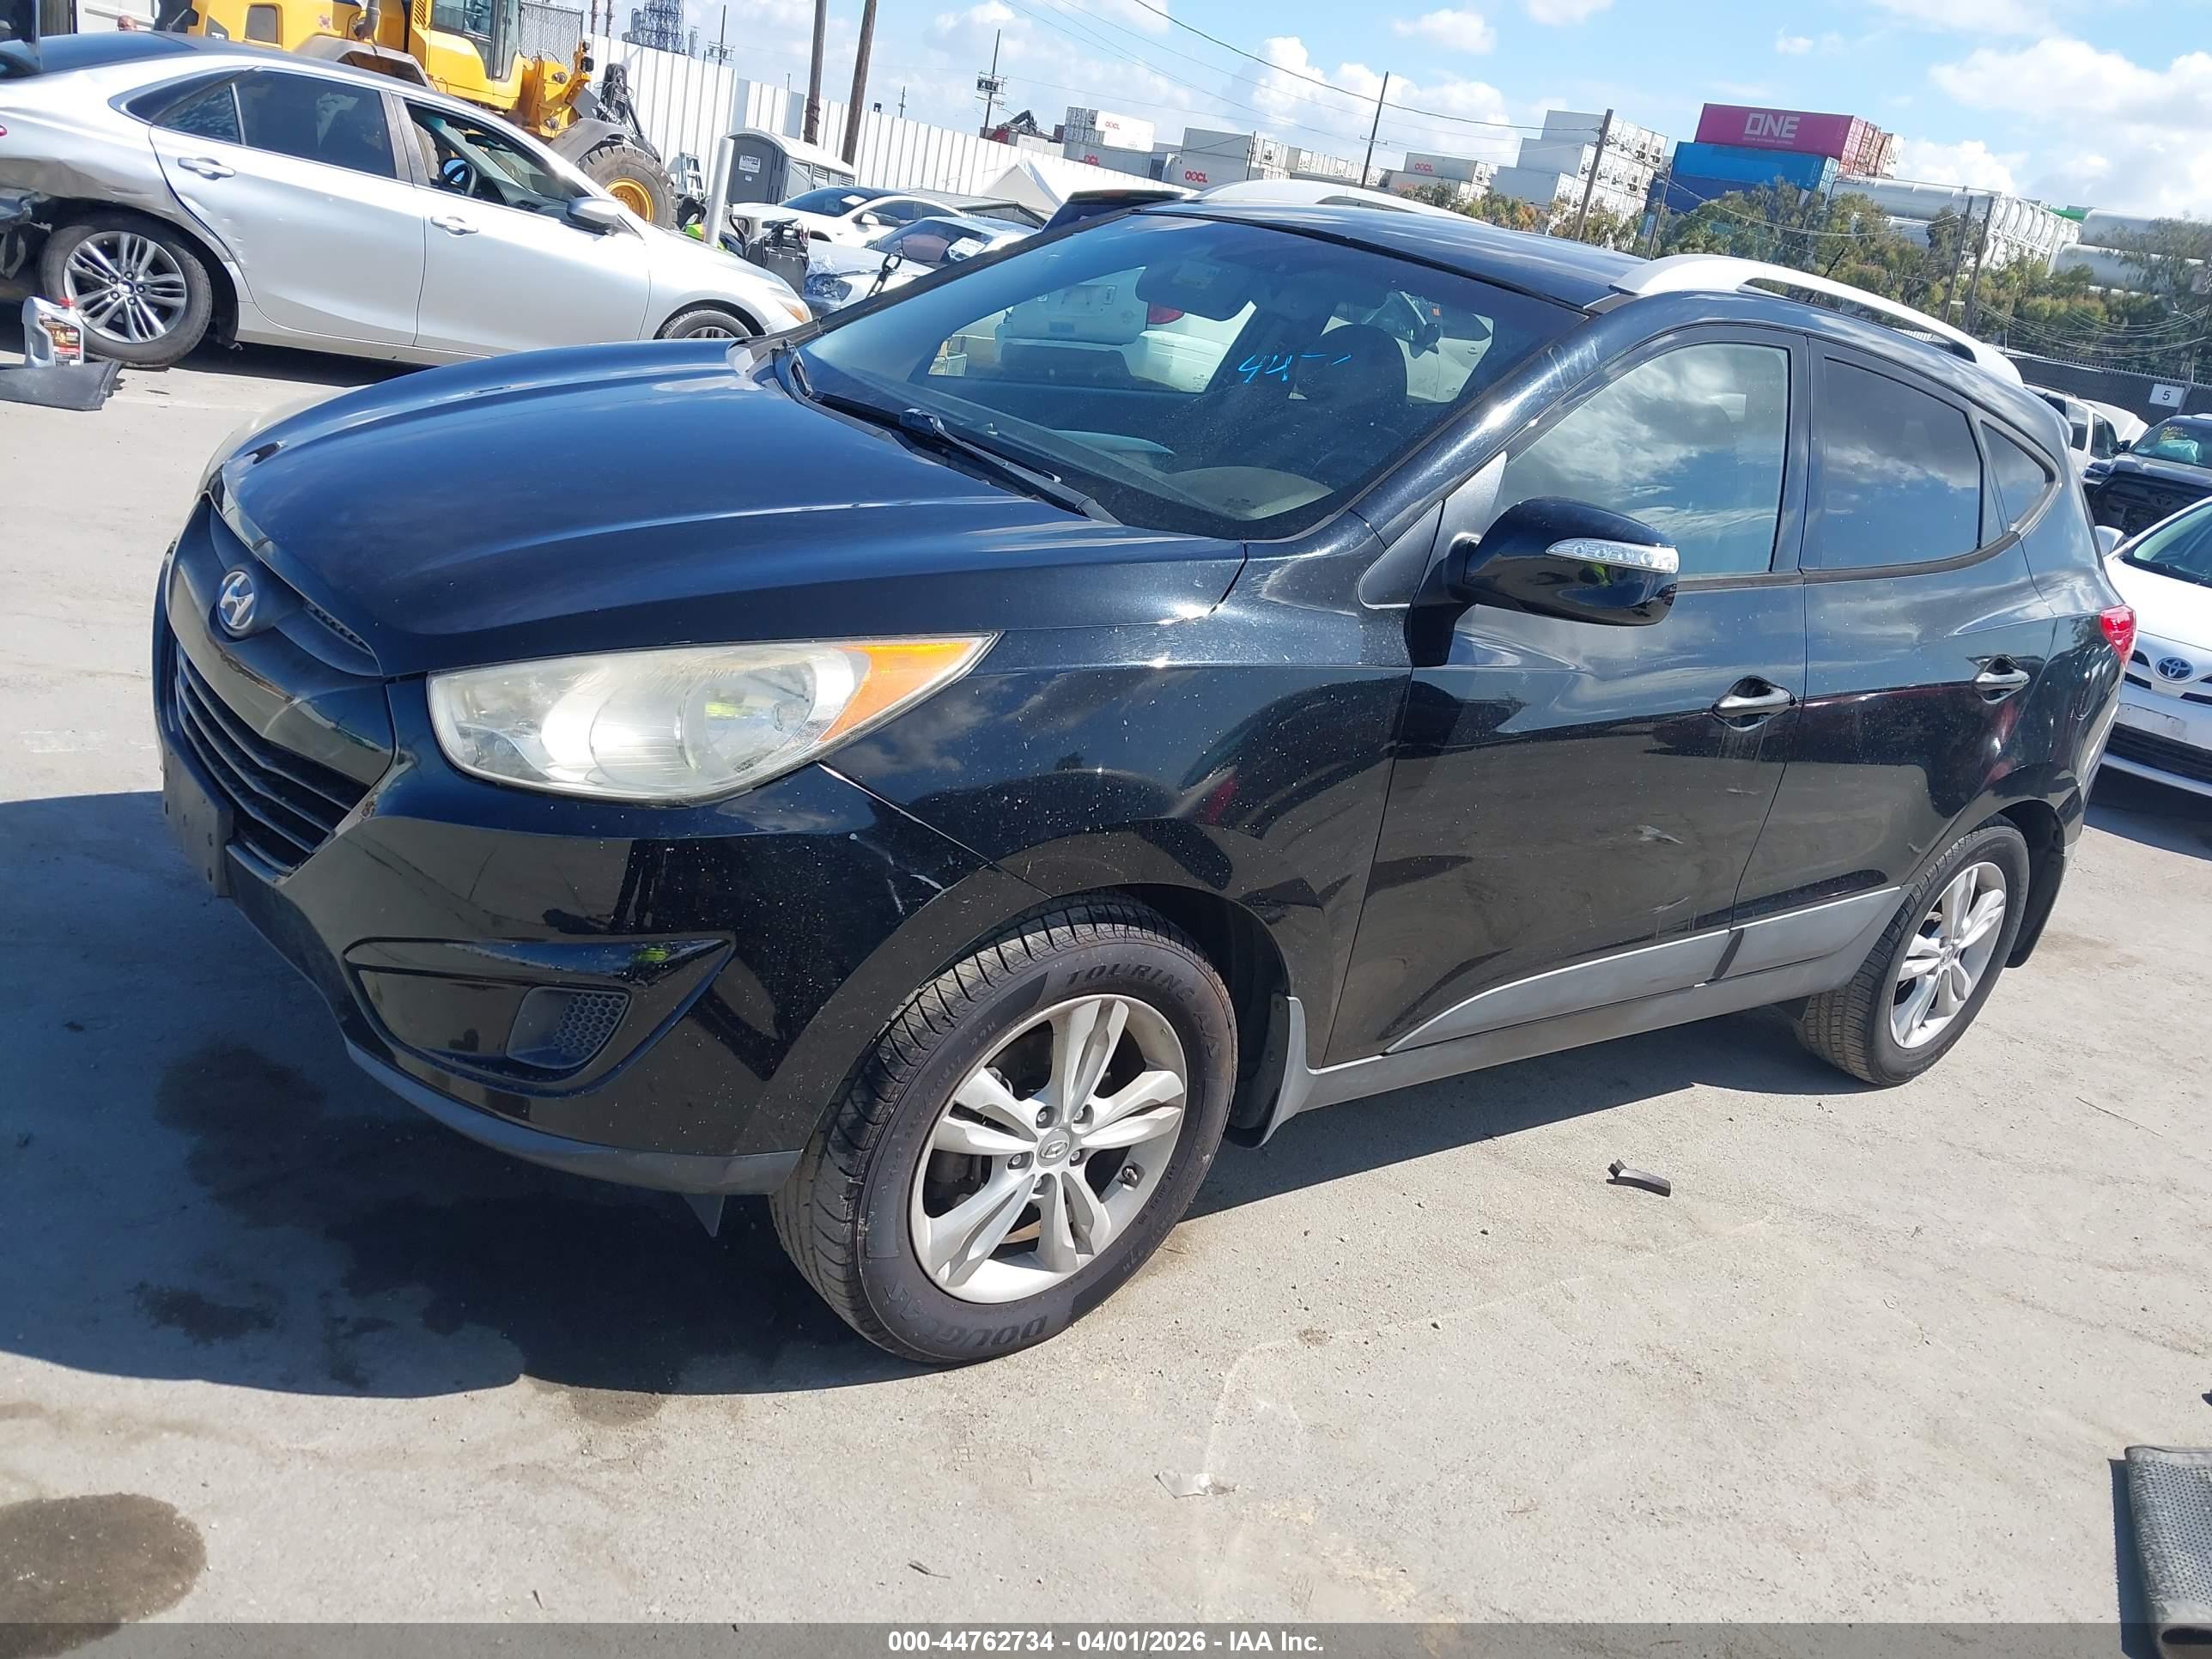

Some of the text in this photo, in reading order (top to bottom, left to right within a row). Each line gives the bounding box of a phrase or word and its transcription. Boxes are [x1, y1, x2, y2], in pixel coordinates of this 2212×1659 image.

[1104, 121, 1120, 130] OOCL
[1745, 112, 1801, 138] ONE
[1185, 170, 1208, 183] OOCL
[2162, 390, 2172, 401] 5
[1067, 962, 1195, 1003] TOURING
